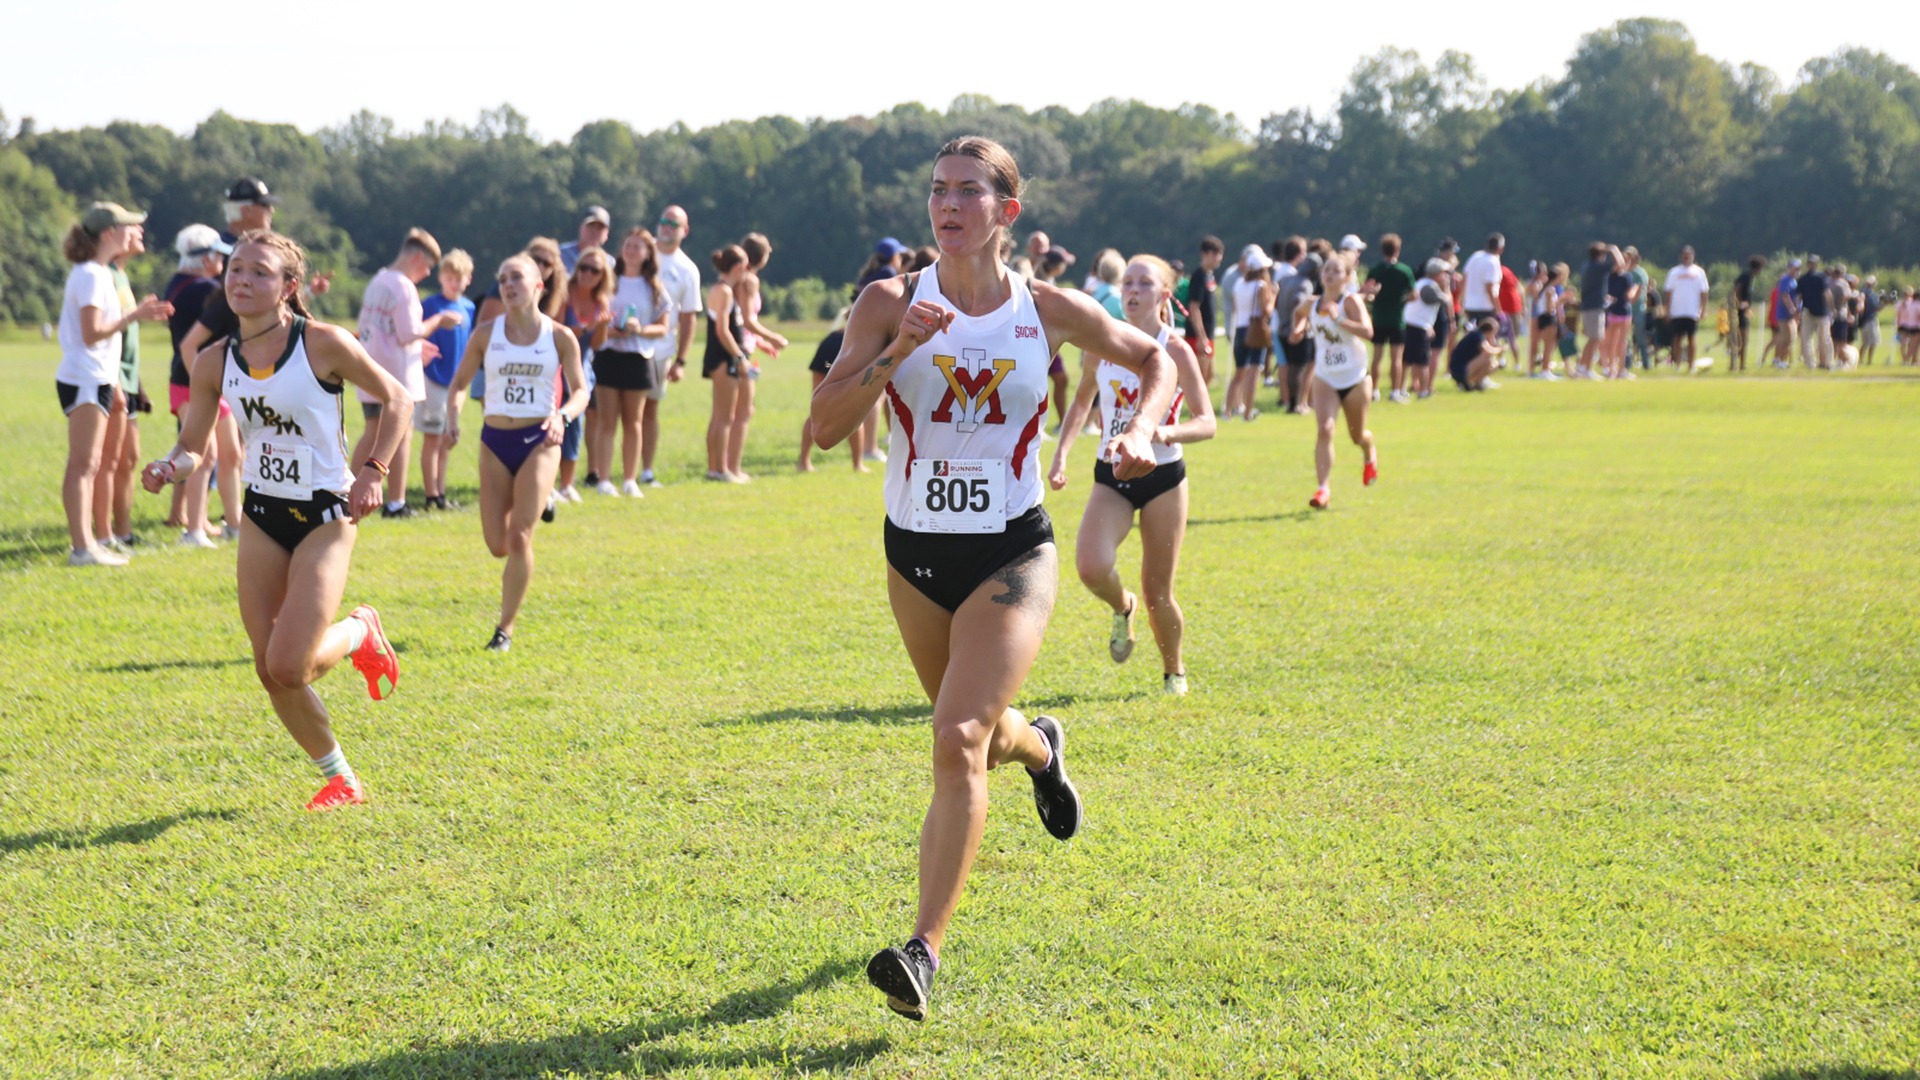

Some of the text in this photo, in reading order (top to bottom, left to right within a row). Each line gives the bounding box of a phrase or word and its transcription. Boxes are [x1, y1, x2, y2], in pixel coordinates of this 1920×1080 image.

[498, 362, 544, 377] JMU
[504, 386, 534, 404] 621
[259, 455, 300, 484] 834
[925, 477, 990, 513] 805
